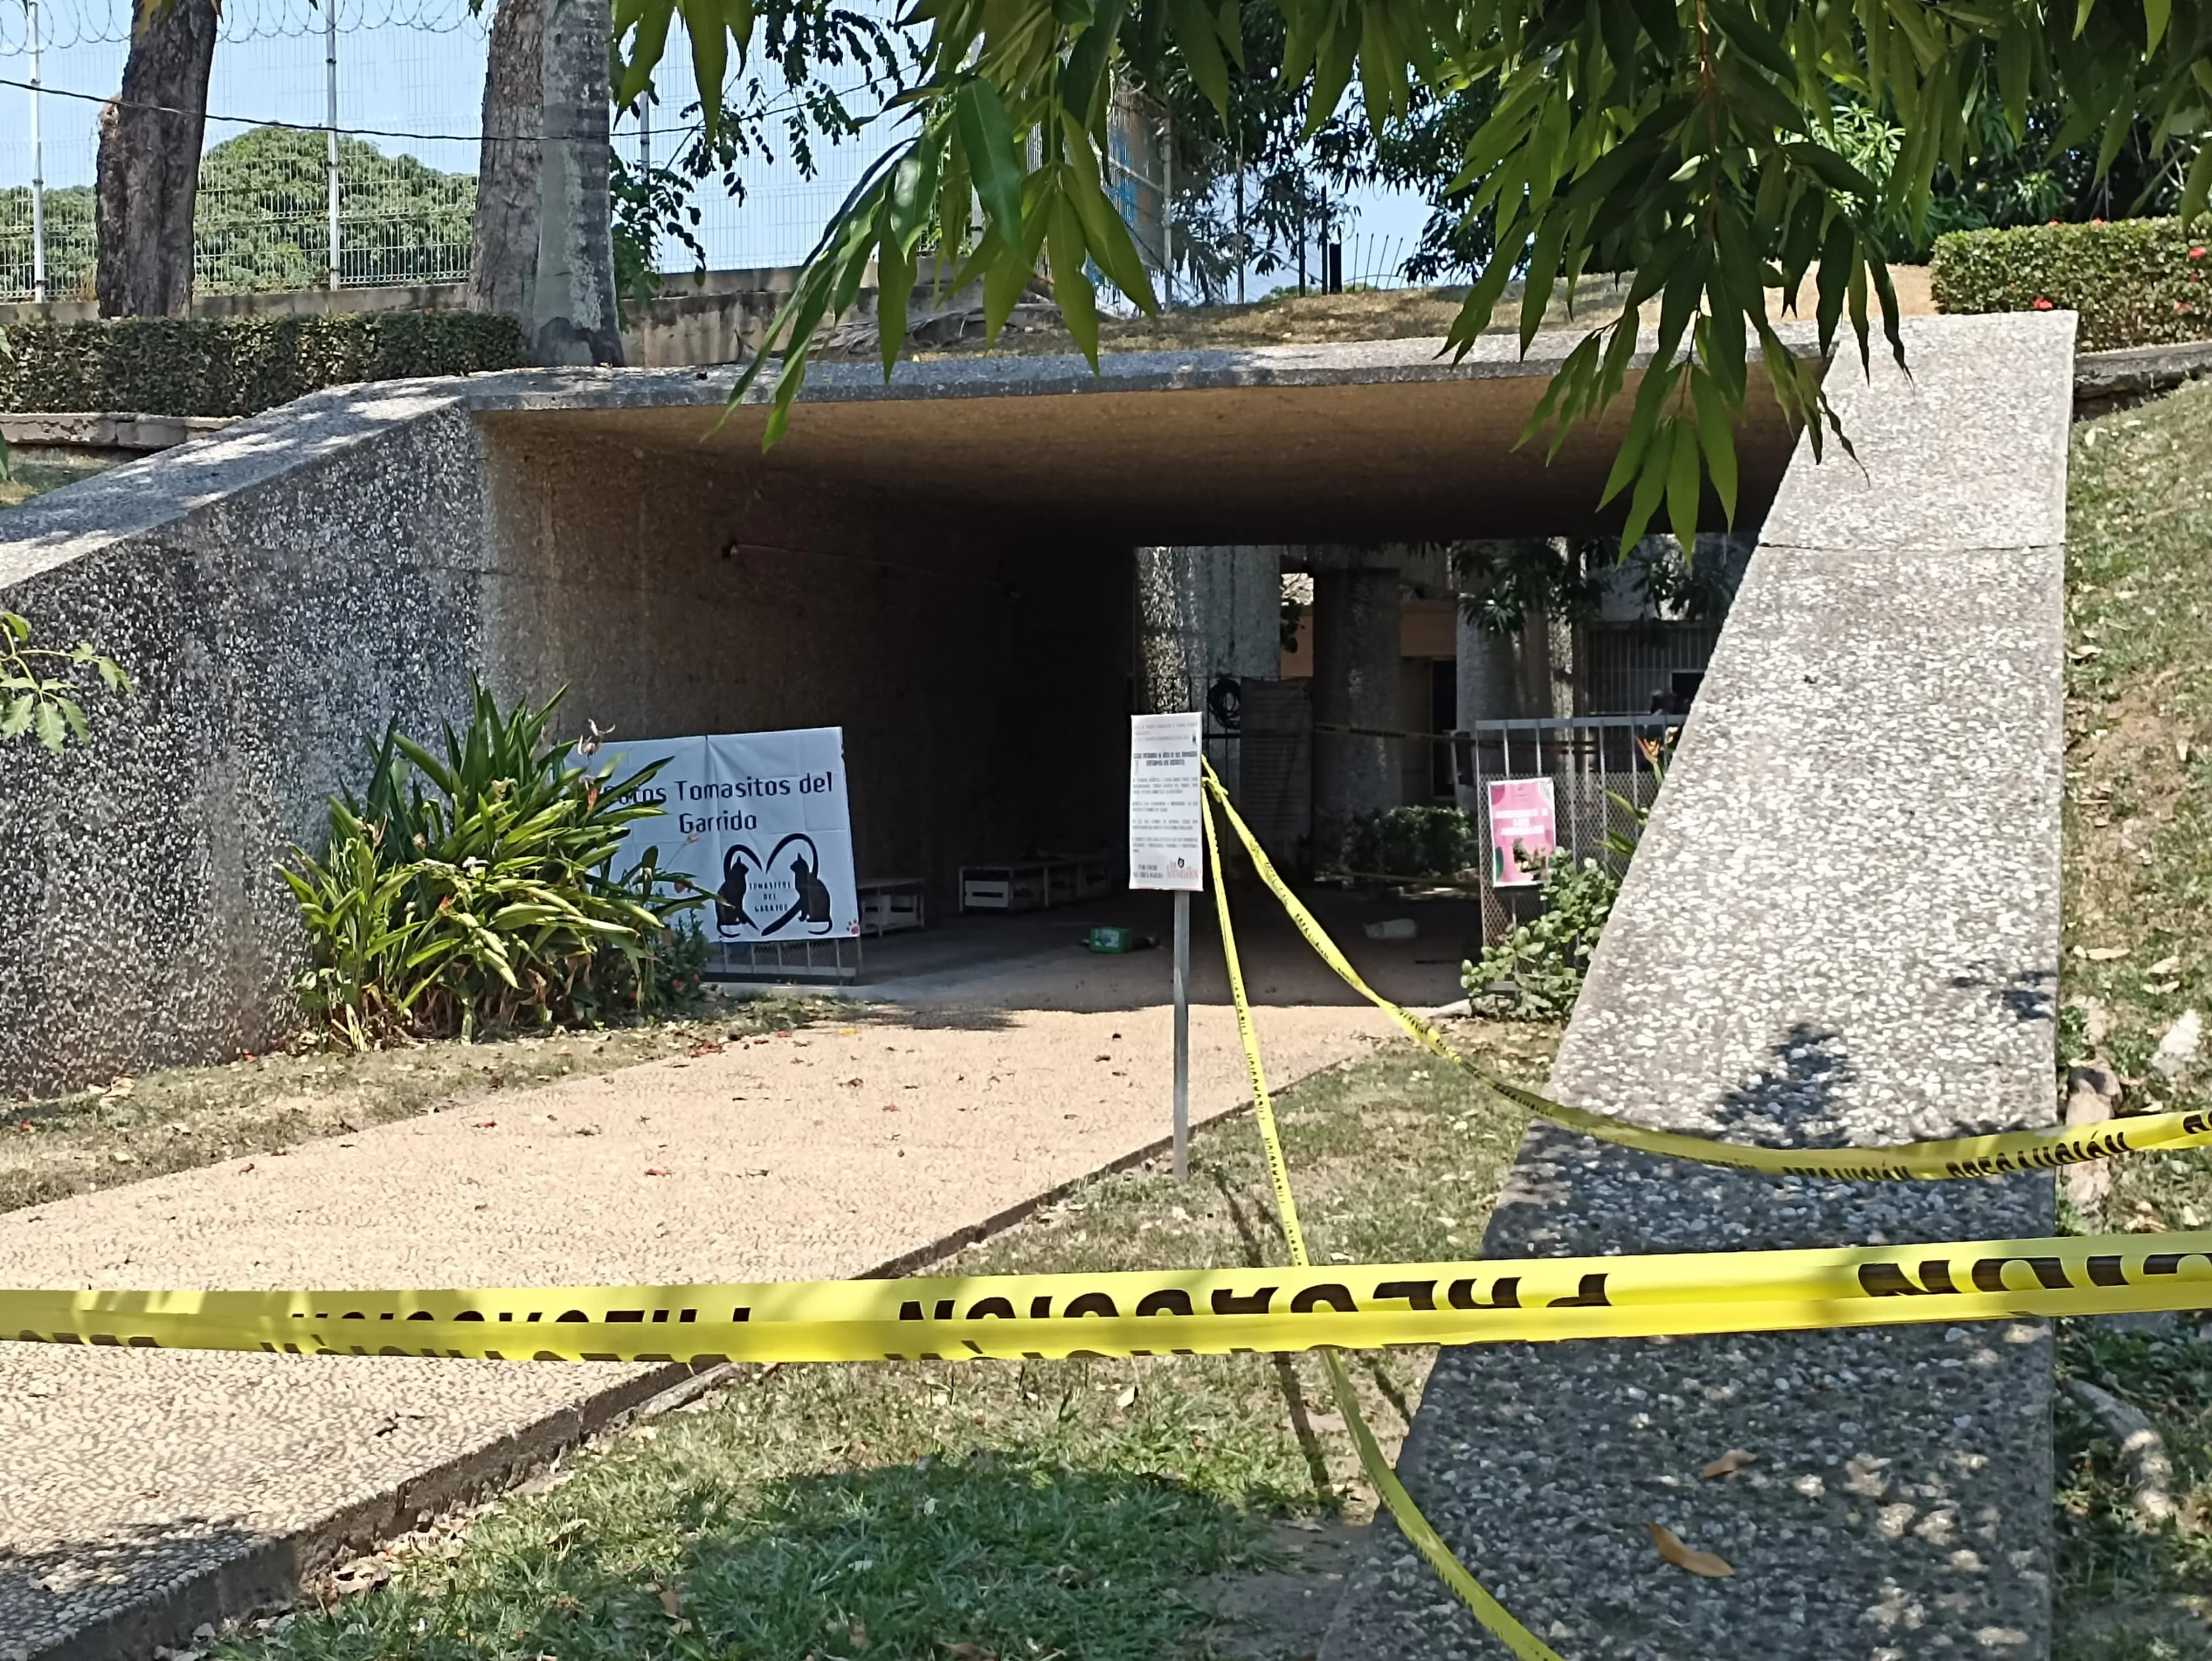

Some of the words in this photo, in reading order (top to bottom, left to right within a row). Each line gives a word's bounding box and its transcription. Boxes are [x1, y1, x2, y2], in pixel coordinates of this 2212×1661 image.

[674, 776, 791, 801] Tomasitos
[799, 771, 833, 794] del
[679, 810, 757, 834] Garrido
